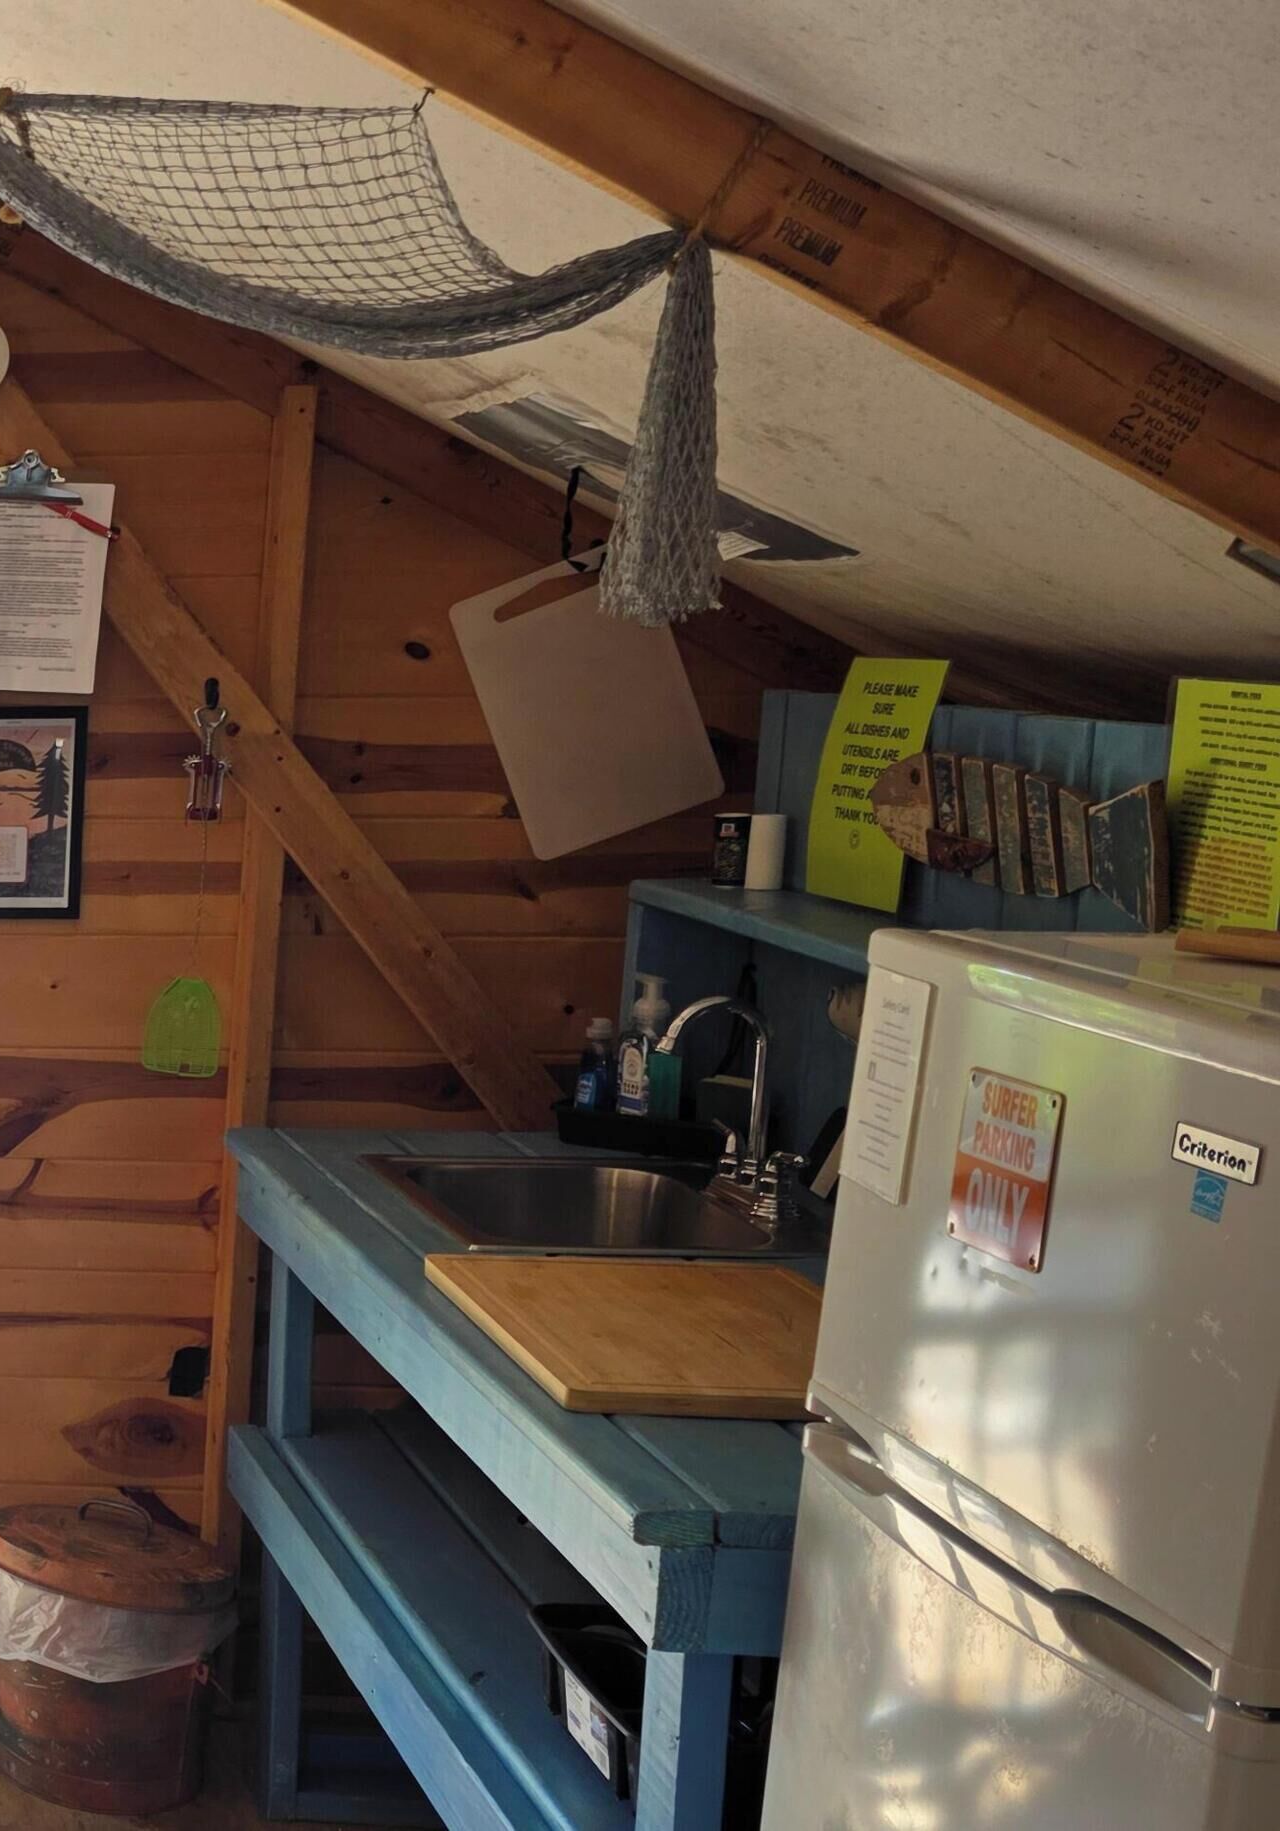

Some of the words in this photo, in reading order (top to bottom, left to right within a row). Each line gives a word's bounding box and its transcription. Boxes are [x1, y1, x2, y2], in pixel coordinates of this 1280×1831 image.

[798, 177, 868, 231] PREMIUM
[774, 216, 844, 266] PREMIUM
[1118, 402, 1146, 431] 2
[1144, 415, 1190, 444] KD-HT
[1141, 445, 1172, 471] NLGA
[863, 681, 895, 696] PLEASE
[894, 684, 920, 698] MAKE
[872, 702, 896, 716] SURE
[844, 722, 861, 736] ALL
[861, 724, 891, 738] DISHES
[890, 726, 910, 740] AND
[842, 744, 881, 760] UTENSILS
[881, 748, 901, 762] ARE
[841, 763, 858, 777] DRY
[858, 765, 886, 780] BEFO
[831, 783, 865, 800] PUTTING
[834, 806, 861, 823] THANK
[981, 1081, 1039, 1130] SURFER
[973, 1119, 1036, 1172] PARKING
[1178, 1133, 1247, 1173] Criterion
[965, 1167, 1030, 1249] ONLY
